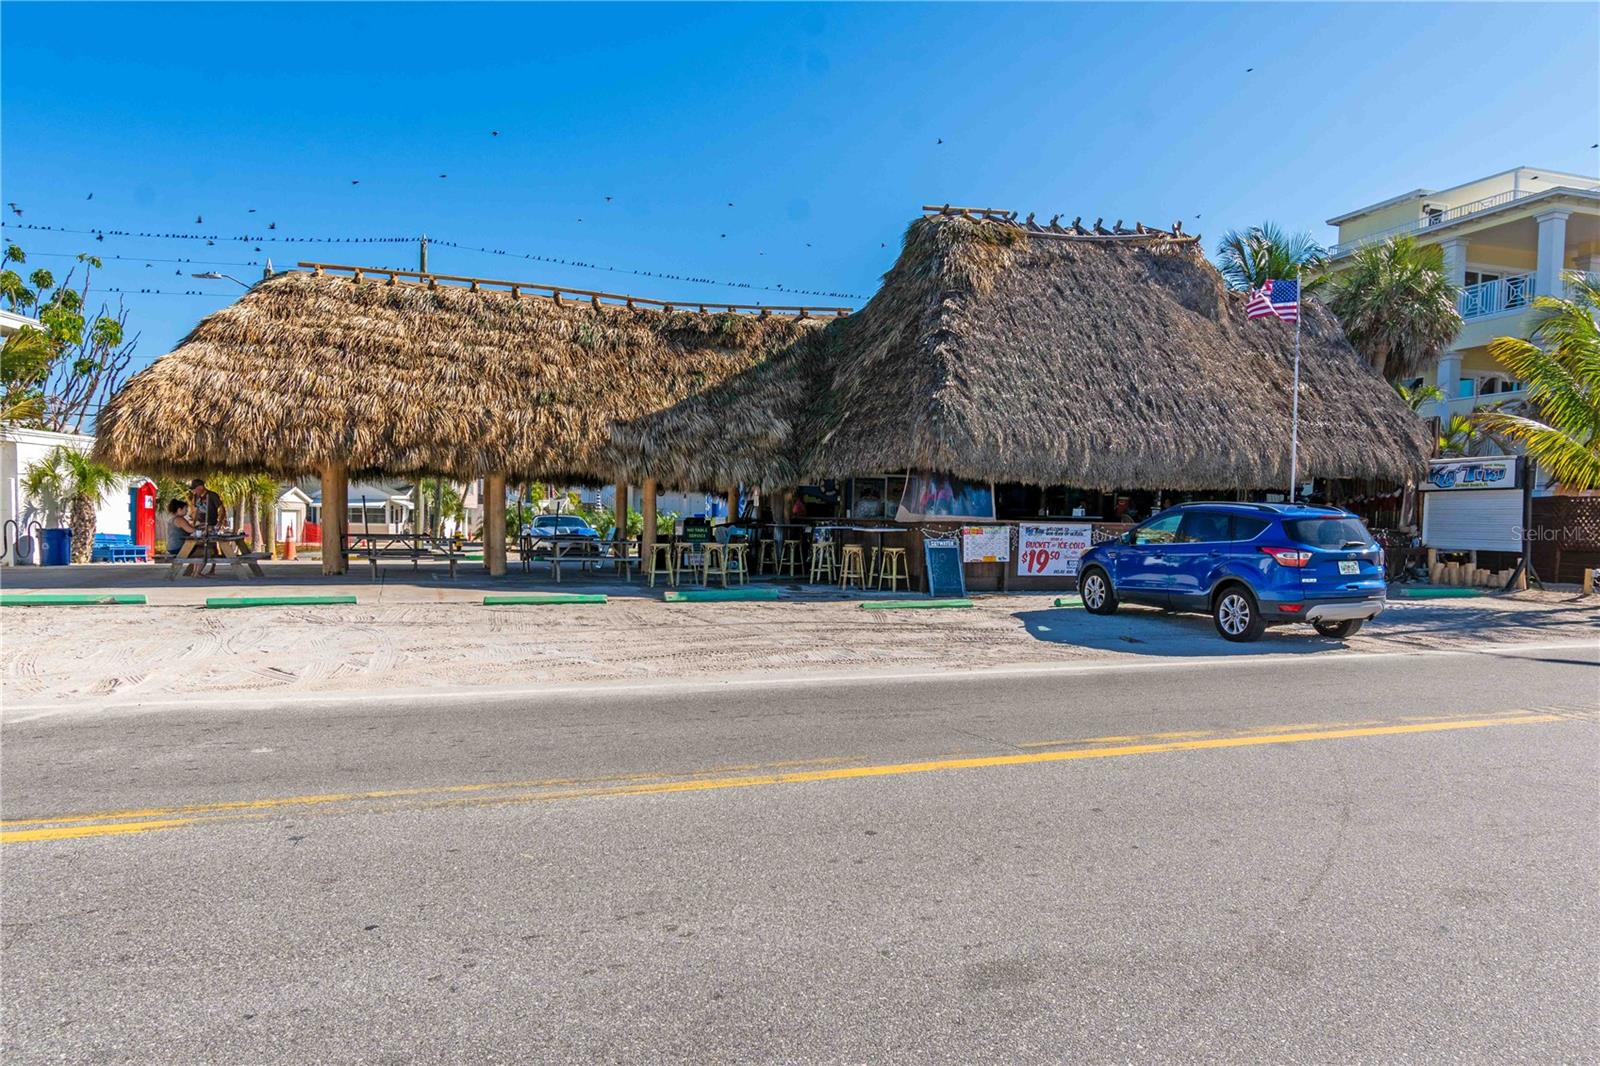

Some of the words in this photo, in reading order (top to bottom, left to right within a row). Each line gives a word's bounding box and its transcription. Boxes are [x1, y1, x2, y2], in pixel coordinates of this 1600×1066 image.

[1025, 541, 1050, 549] BUCKET
[1057, 541, 1068, 549] ICE
[1069, 542, 1086, 550] COLD
